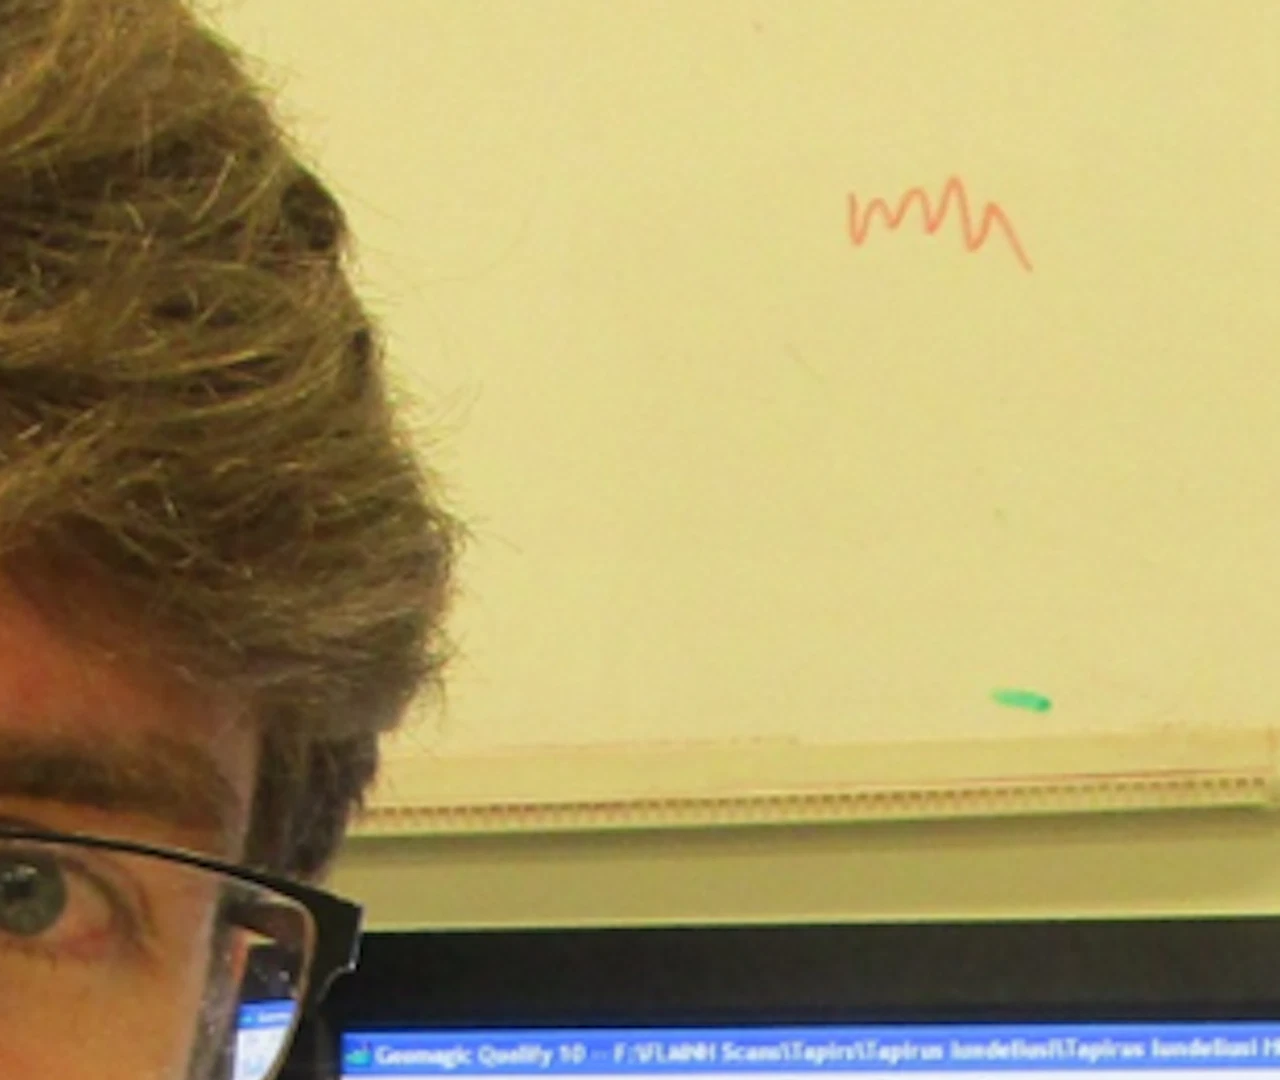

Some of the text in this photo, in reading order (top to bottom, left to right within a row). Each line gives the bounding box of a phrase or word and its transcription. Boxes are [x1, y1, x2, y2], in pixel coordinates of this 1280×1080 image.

[374, 1044, 472, 1069] Geomagic
[477, 1042, 554, 1068] Qualify
[559, 1042, 588, 1064] 10
